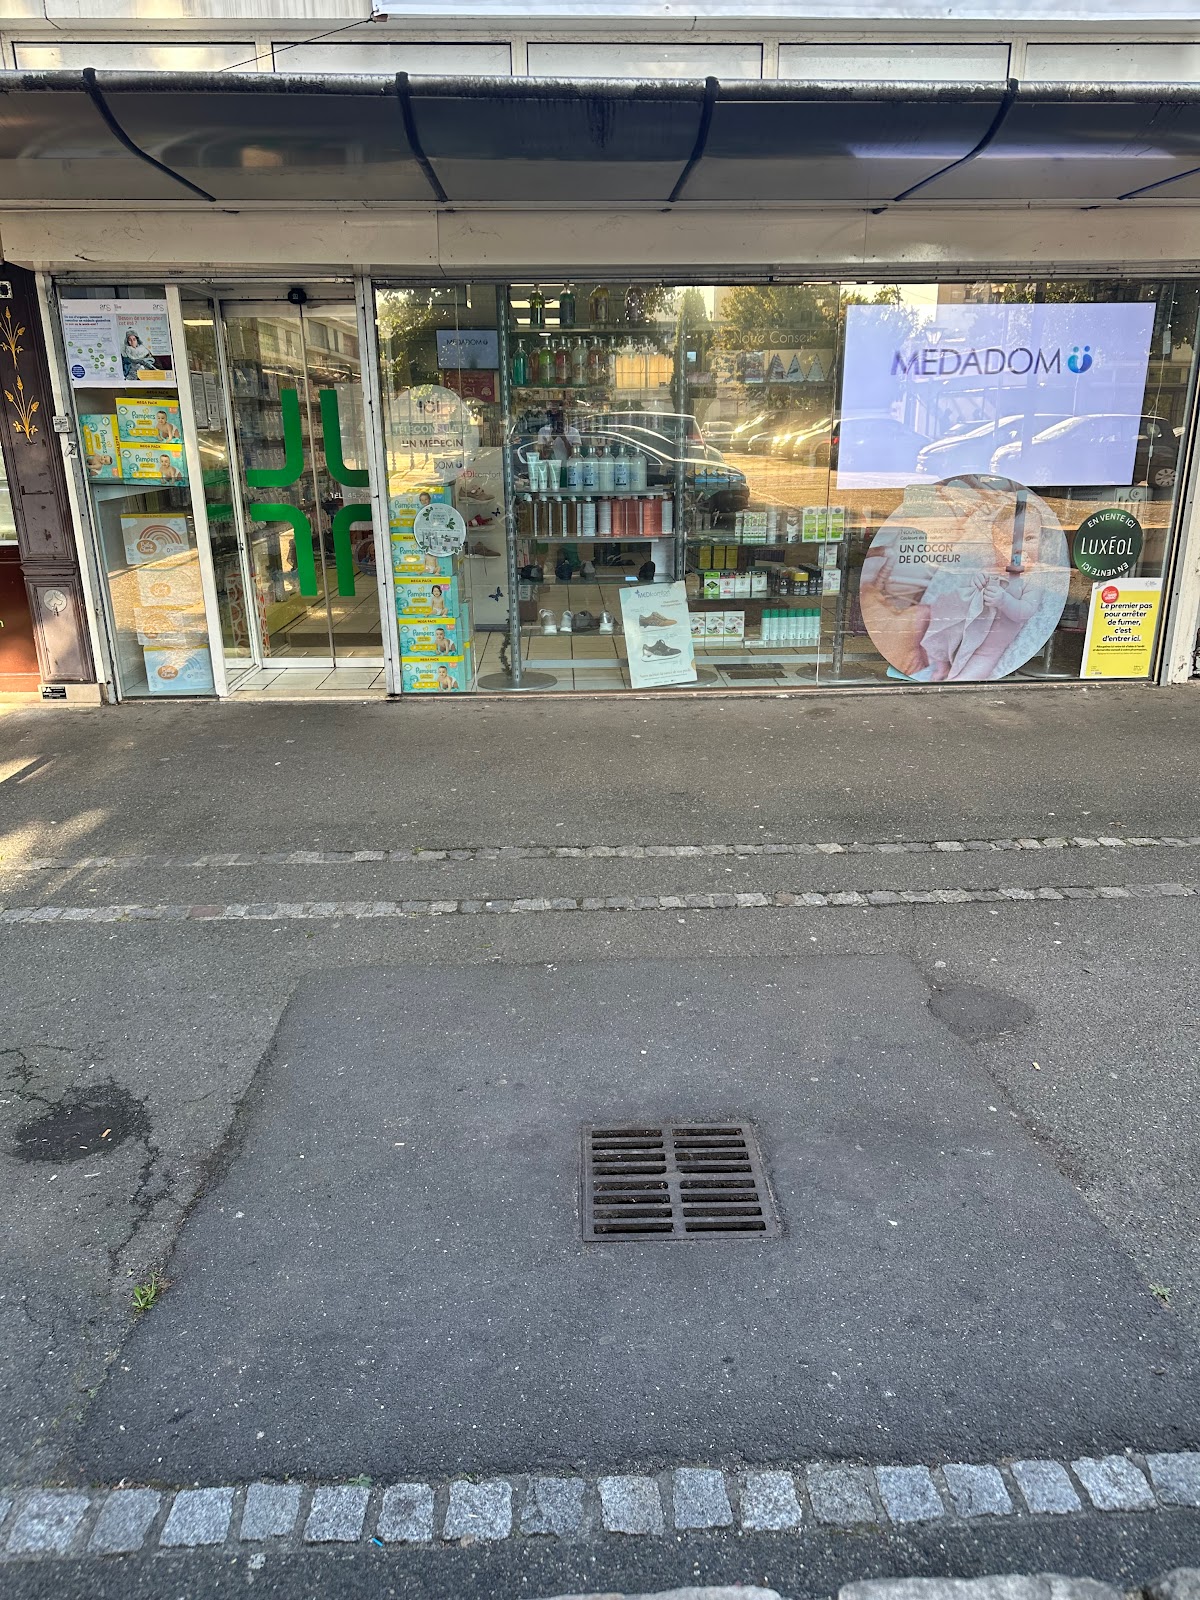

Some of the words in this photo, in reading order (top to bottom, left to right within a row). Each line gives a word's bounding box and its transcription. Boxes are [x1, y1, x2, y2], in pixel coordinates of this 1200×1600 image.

[890, 348, 1060, 376] MEDADOM
[132, 411, 156, 420] Pampers
[420, 438, 464, 447] MÉDECIN
[135, 454, 159, 463] Pampers
[395, 500, 420, 509] Pampers
[1087, 517, 1099, 528] EN
[1100, 513, 1126, 522] VENTE
[1125, 518, 1136, 528] ICI
[900, 545, 914, 553] UN
[917, 544, 953, 553] COCON
[1080, 536, 1134, 555] LUXÉOL
[400, 546, 424, 556] Pampers
[914, 554, 960, 563] DOUCEUR
[1081, 562, 1090, 572] ICI
[1118, 562, 1129, 570] EN
[1091, 568, 1117, 576] VENTE
[407, 590, 431, 599] Pampers
[1110, 602, 1138, 610] premier
[413, 629, 434, 638] Pampers
[416, 667, 437, 676] Pampers
